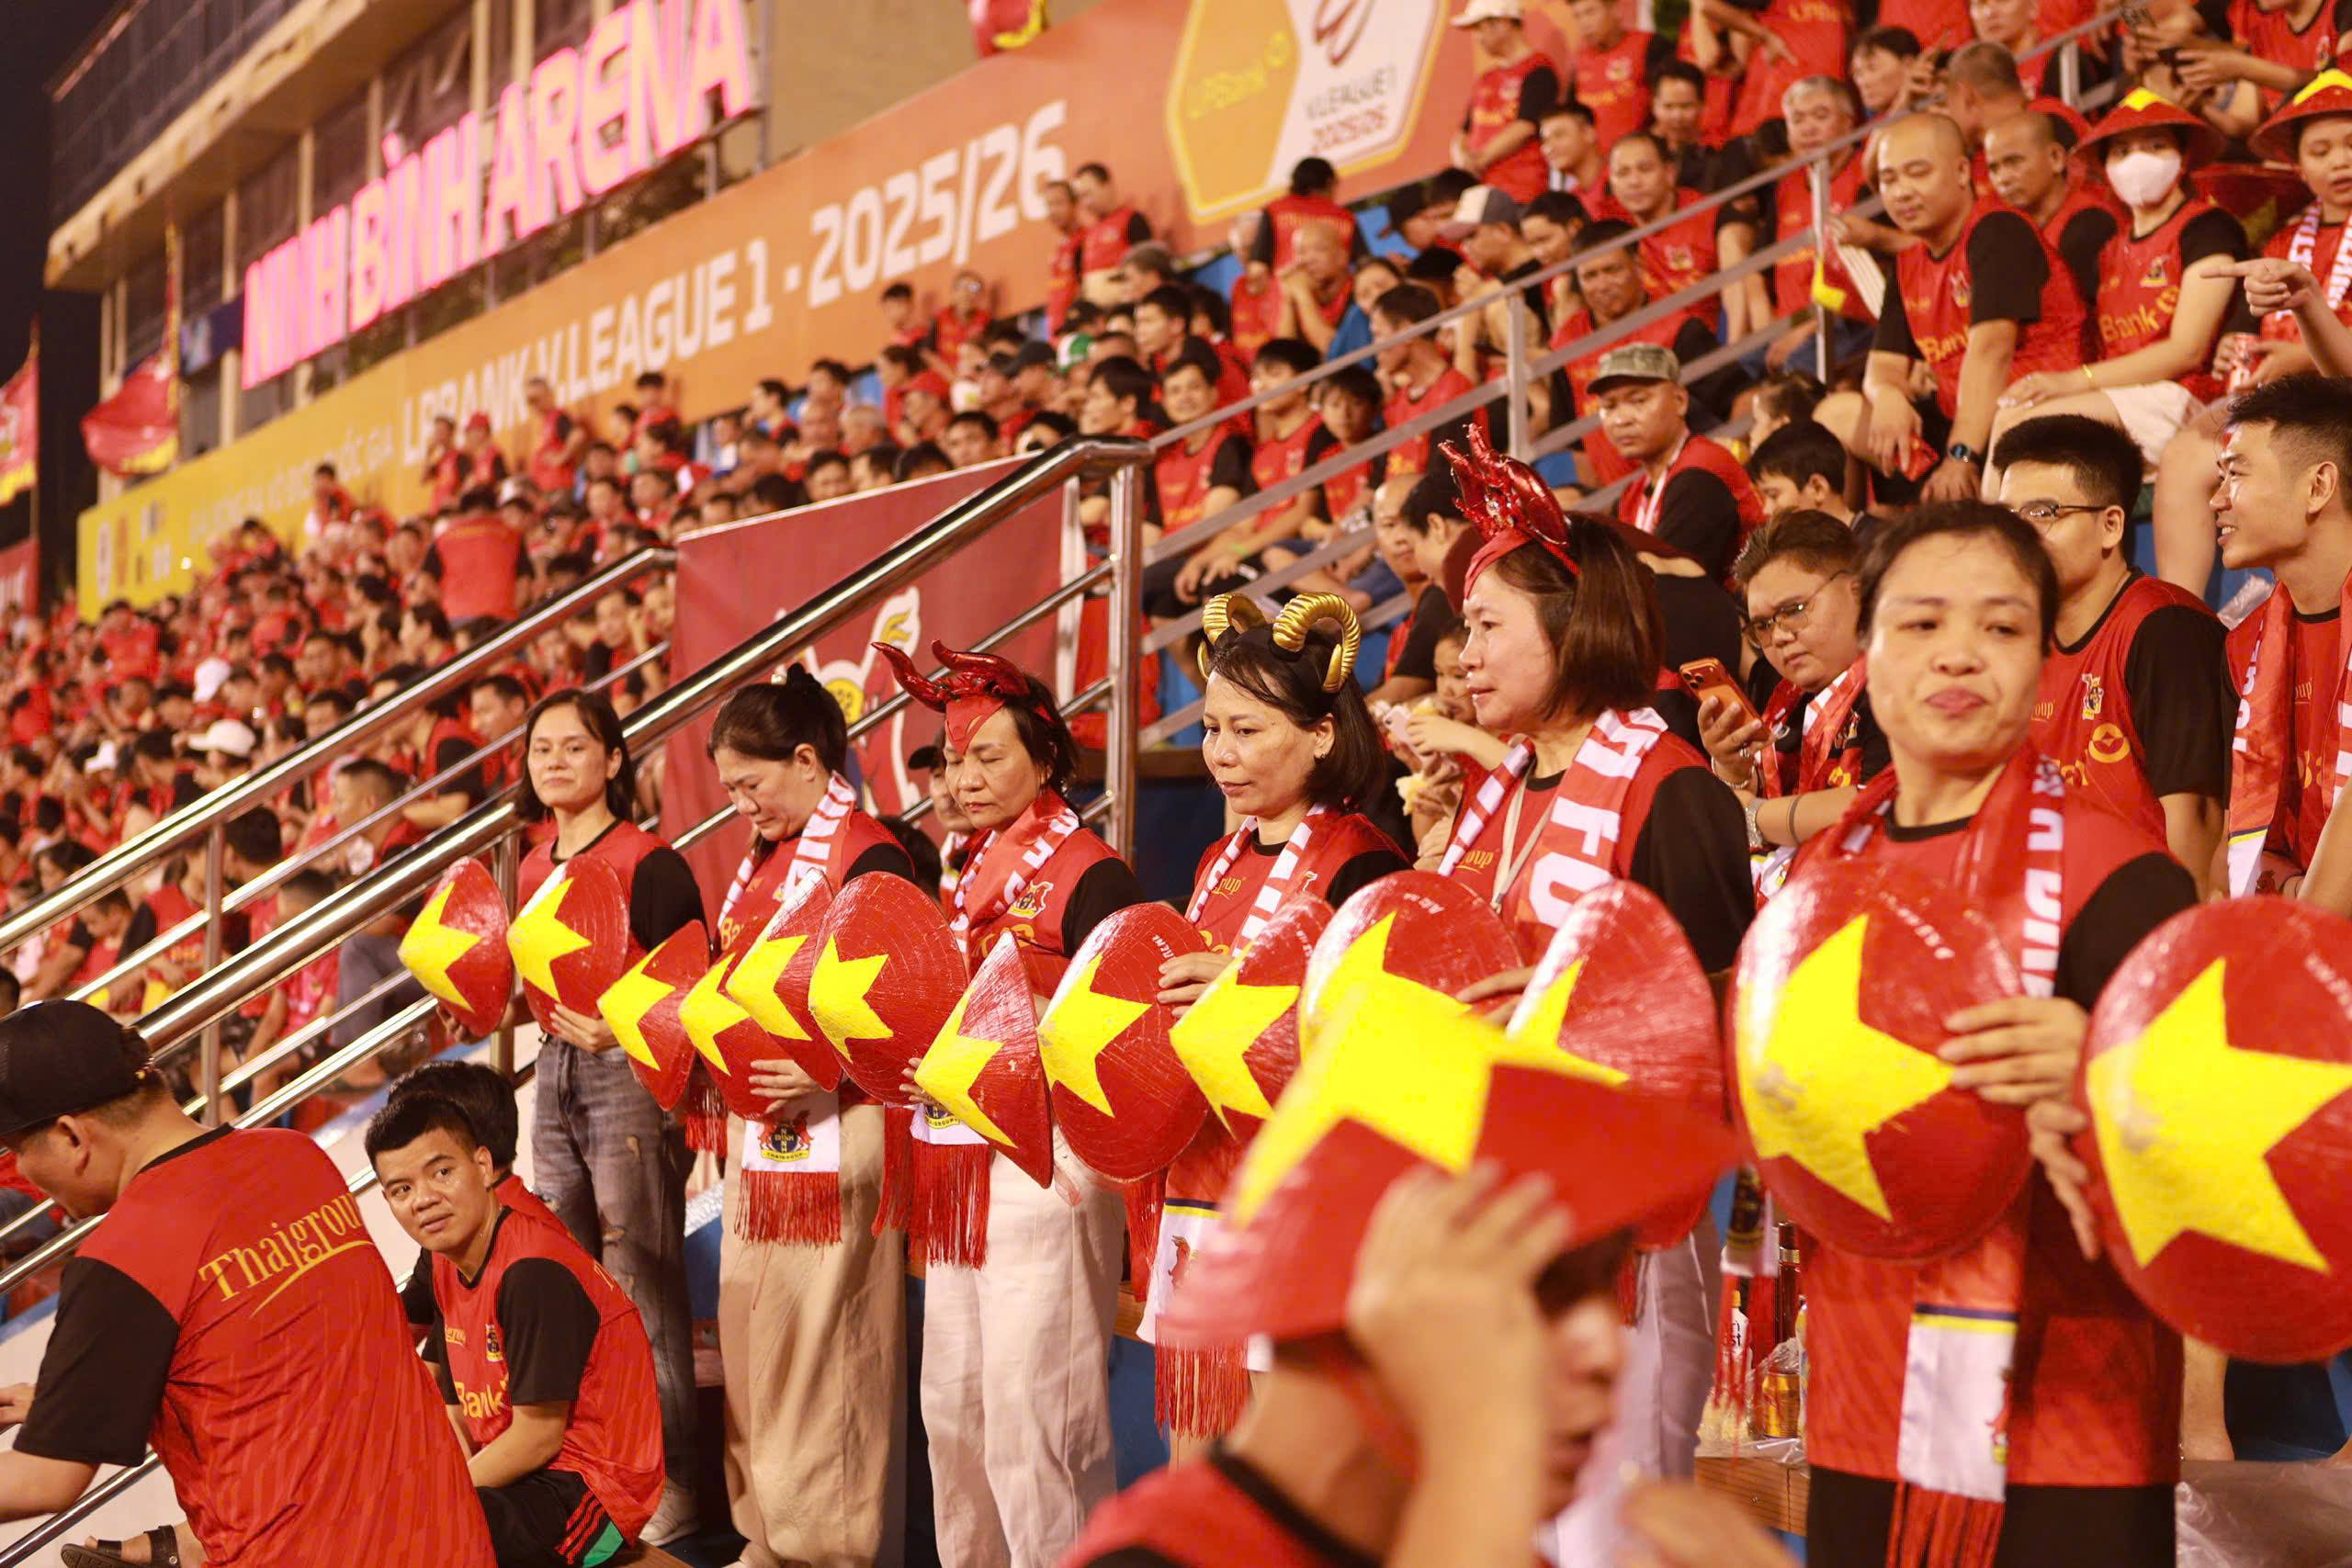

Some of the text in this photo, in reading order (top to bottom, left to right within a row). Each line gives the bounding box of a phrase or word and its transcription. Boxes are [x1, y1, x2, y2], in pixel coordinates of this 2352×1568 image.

[241, 204, 349, 390] NINH
[481, 0, 752, 259] ARENA
[744, 237, 774, 334] 1
[808, 98, 1068, 310] 2025/26
[198, 1192, 364, 1302] Thaigrou
